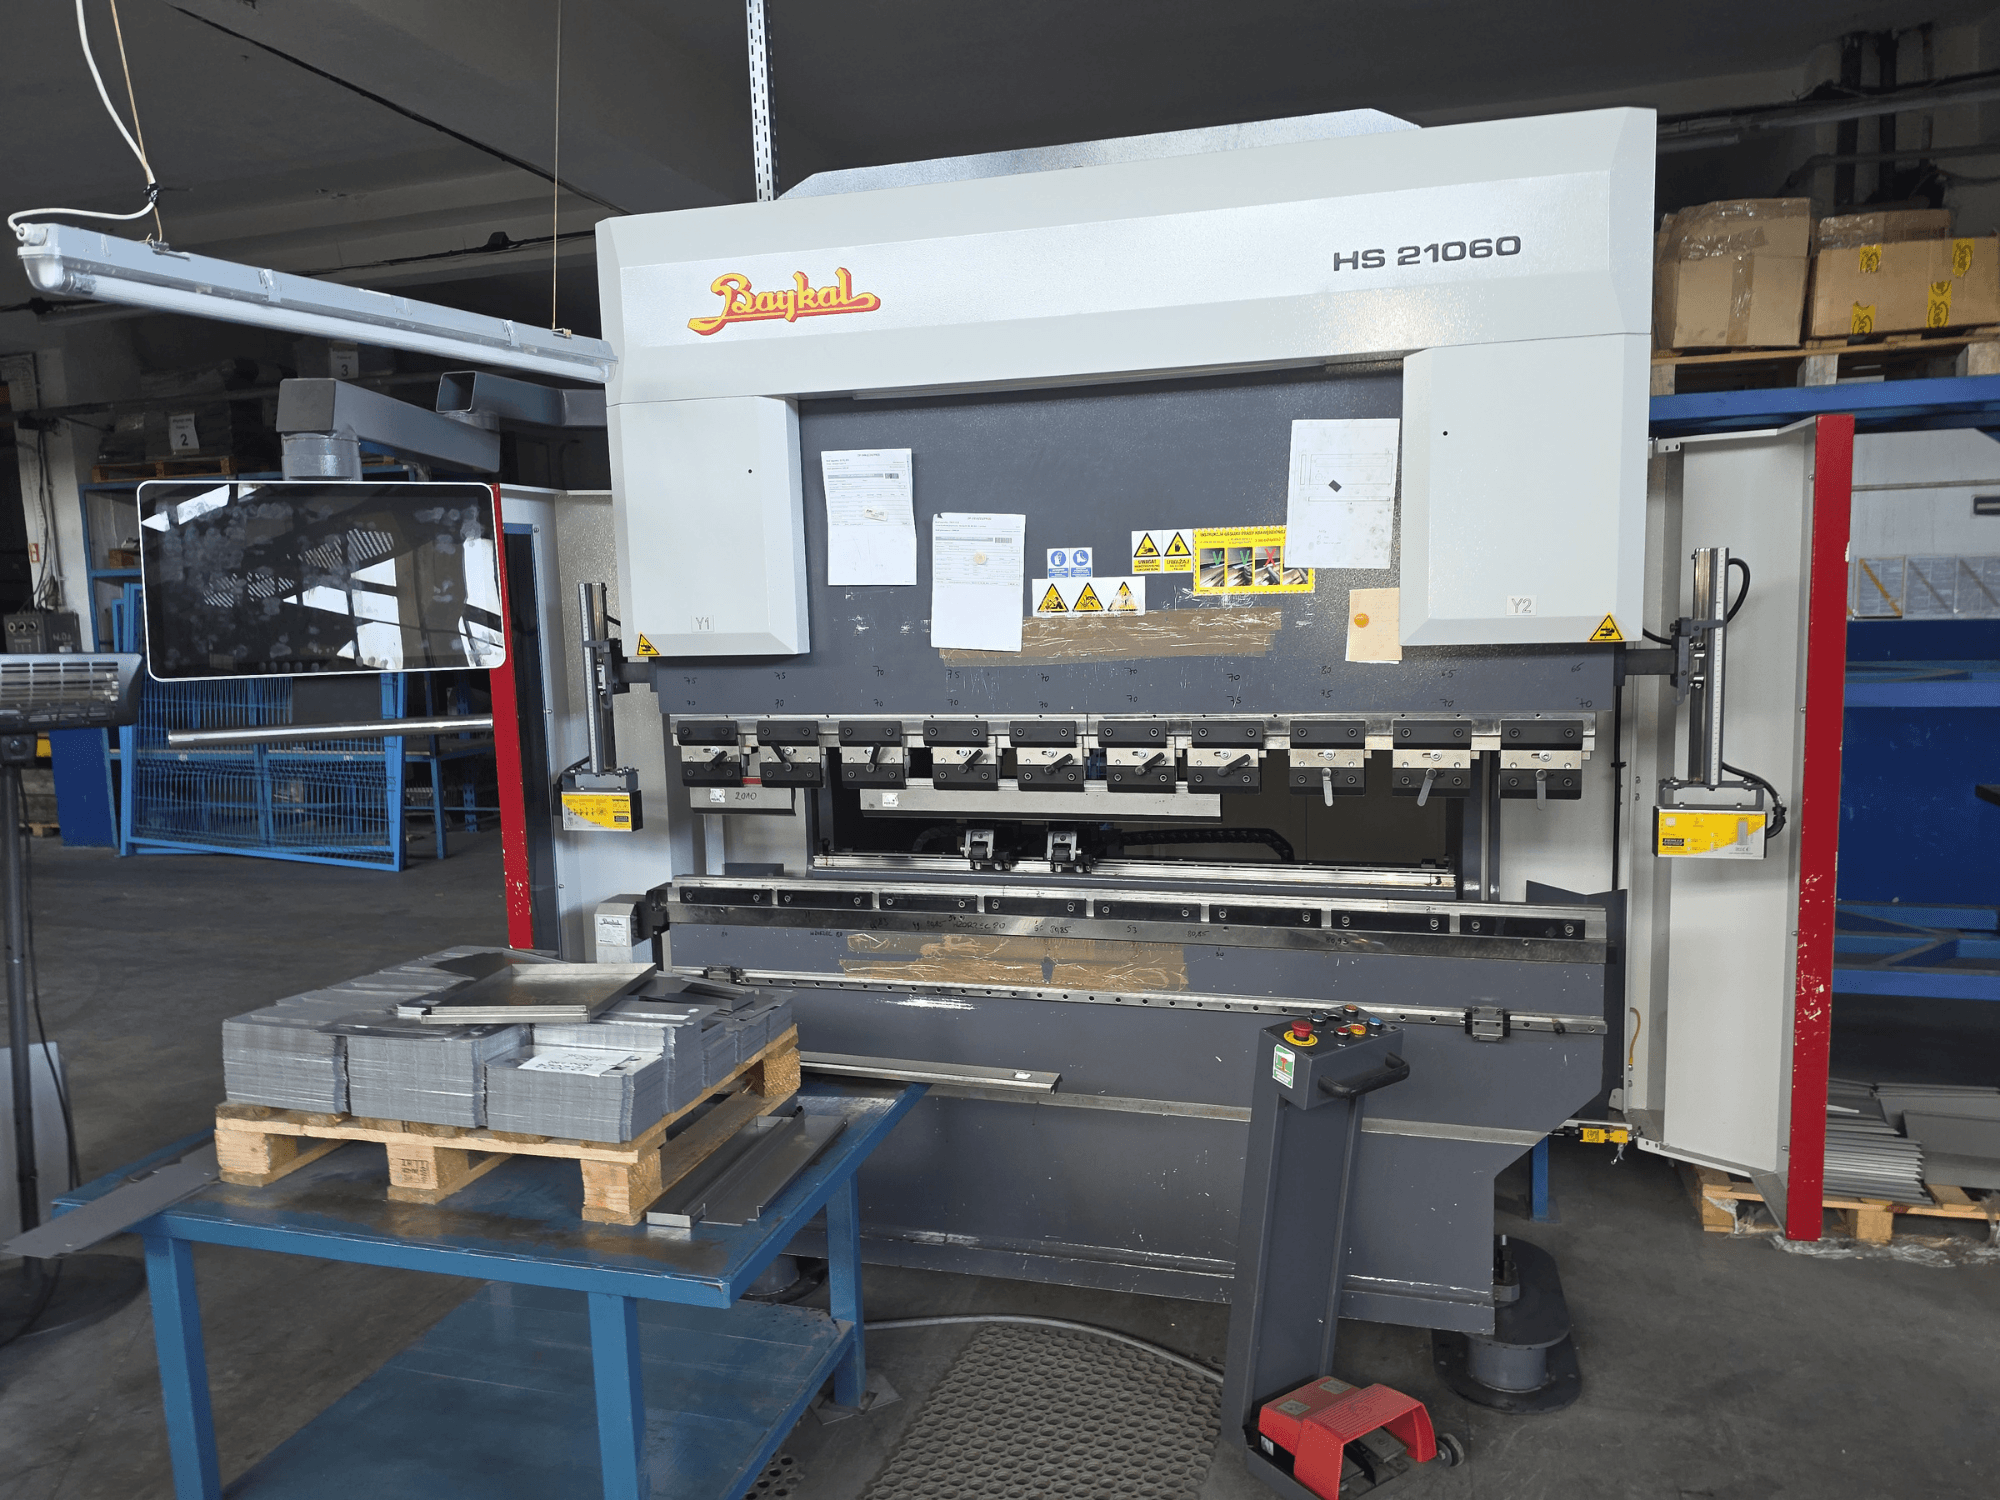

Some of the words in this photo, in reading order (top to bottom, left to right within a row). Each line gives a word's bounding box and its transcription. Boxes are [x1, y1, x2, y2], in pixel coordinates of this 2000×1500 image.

[1333, 248, 1386, 272] HS
[1397, 235, 1522, 267] 21060
[687, 266, 882, 336] Baykal
[341, 364, 349, 377] 3
[180, 433, 189, 447] 2
[1511, 597, 1532, 614] Y2
[695, 616, 711, 631] Y1
[774, 671, 786, 680] 75
[873, 665, 885, 677] 70
[1226, 673, 1241, 682] 70
[873, 698, 884, 708] 70
[734, 791, 757, 801] 2010
